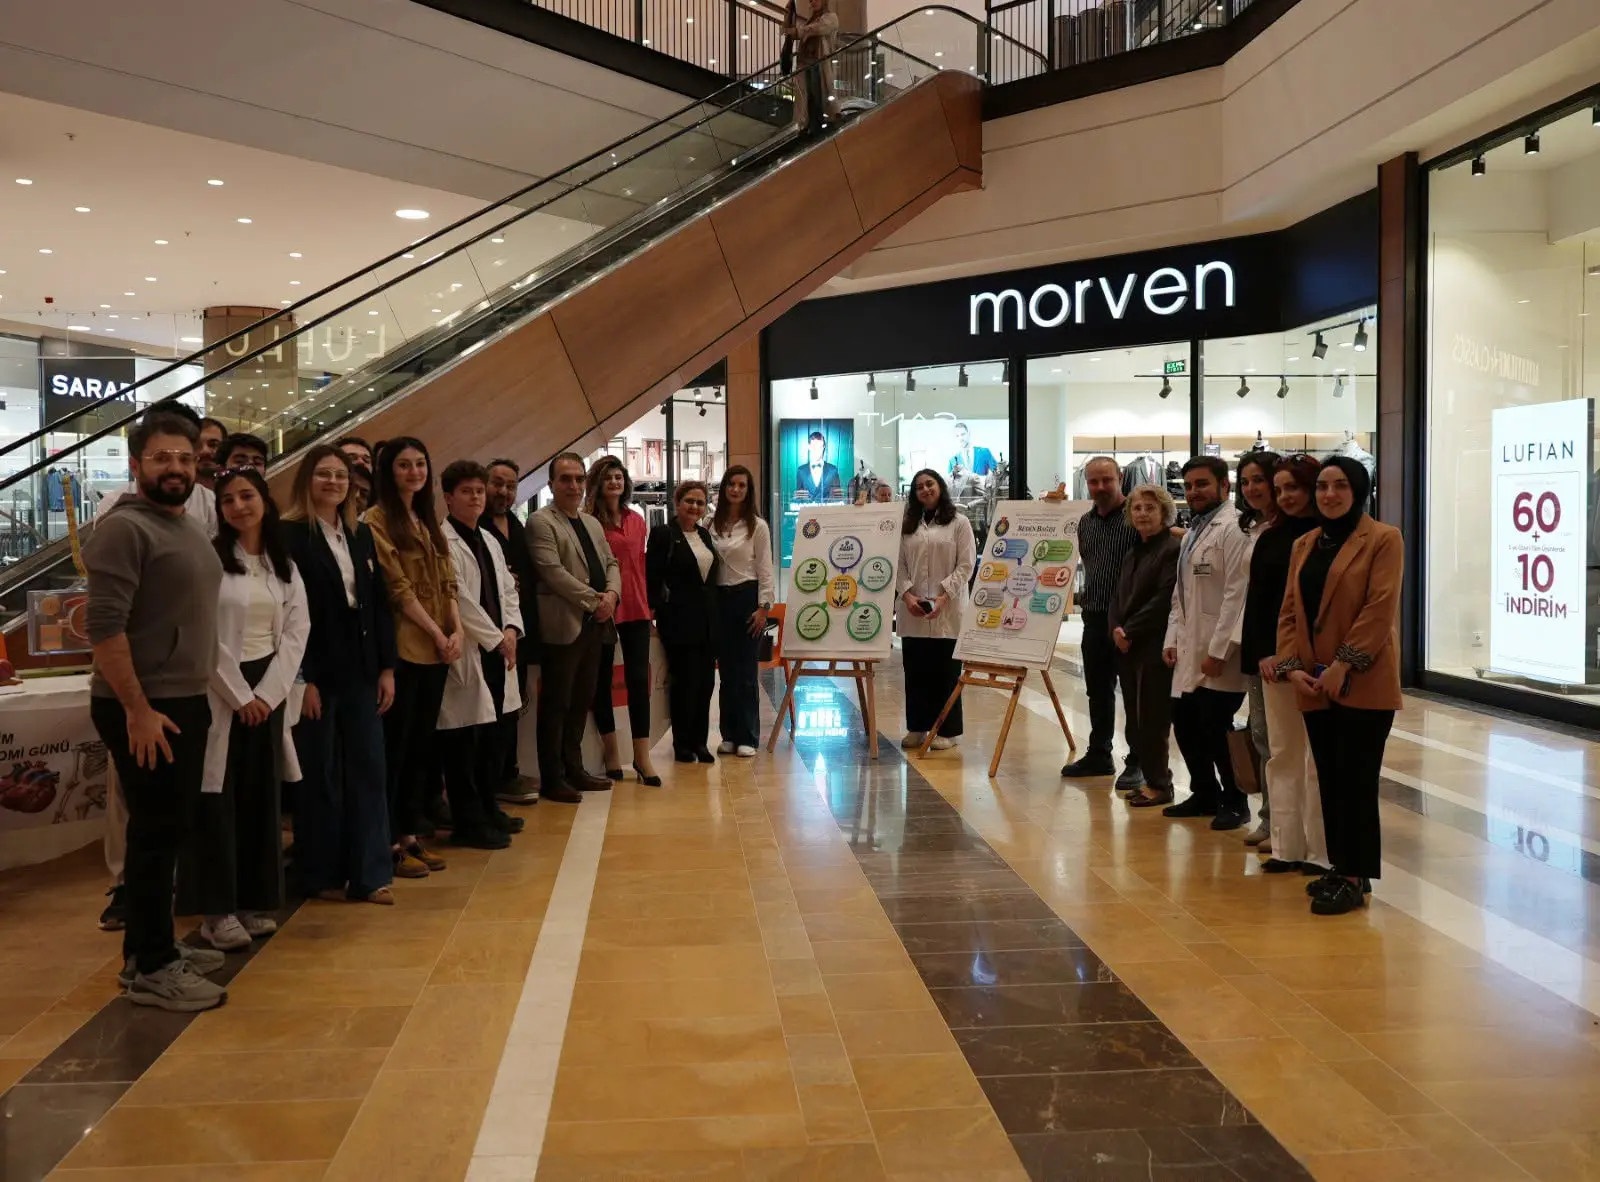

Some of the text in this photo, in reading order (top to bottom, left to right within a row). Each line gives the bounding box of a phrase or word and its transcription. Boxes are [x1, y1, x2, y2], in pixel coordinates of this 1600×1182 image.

[970, 260, 1235, 335] morven
[1503, 440, 1573, 462] LUFIAN
[1513, 491, 1561, 533] 60
[1517, 553, 1554, 593] 10
[1505, 592, 1567, 619] İNDİRİM
[0, 731, 14, 745] M
[28, 738, 70, 757] GÜNÜ
